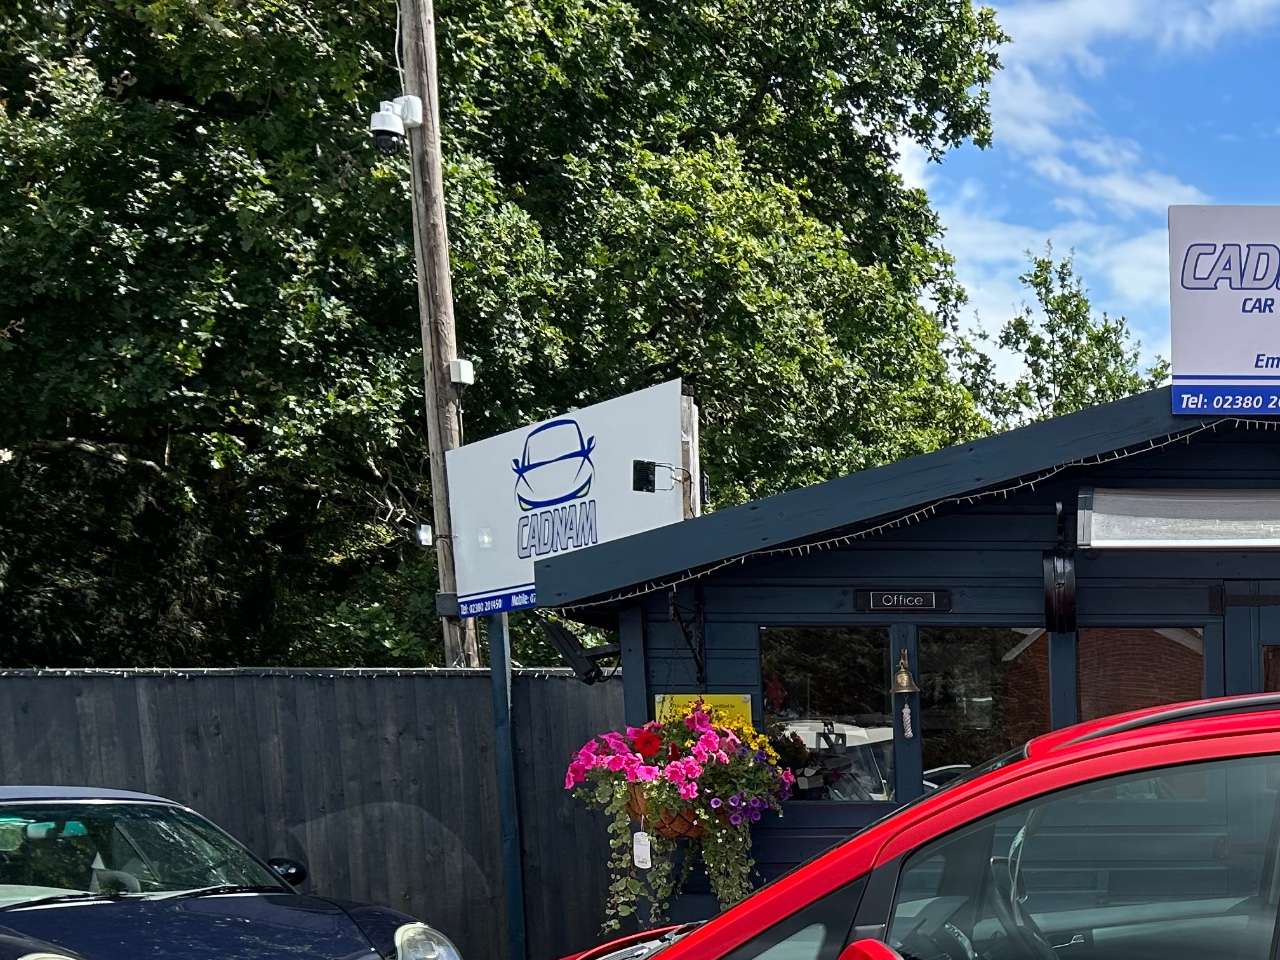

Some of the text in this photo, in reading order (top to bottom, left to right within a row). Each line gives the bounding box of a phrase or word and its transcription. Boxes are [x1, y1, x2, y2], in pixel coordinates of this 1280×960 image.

[1241, 298, 1274, 313] CAR
[1180, 394, 1208, 408] Tel:
[1213, 396, 1263, 408] 02380
[517, 500, 598, 559] CADNAM
[882, 594, 924, 606] Office
